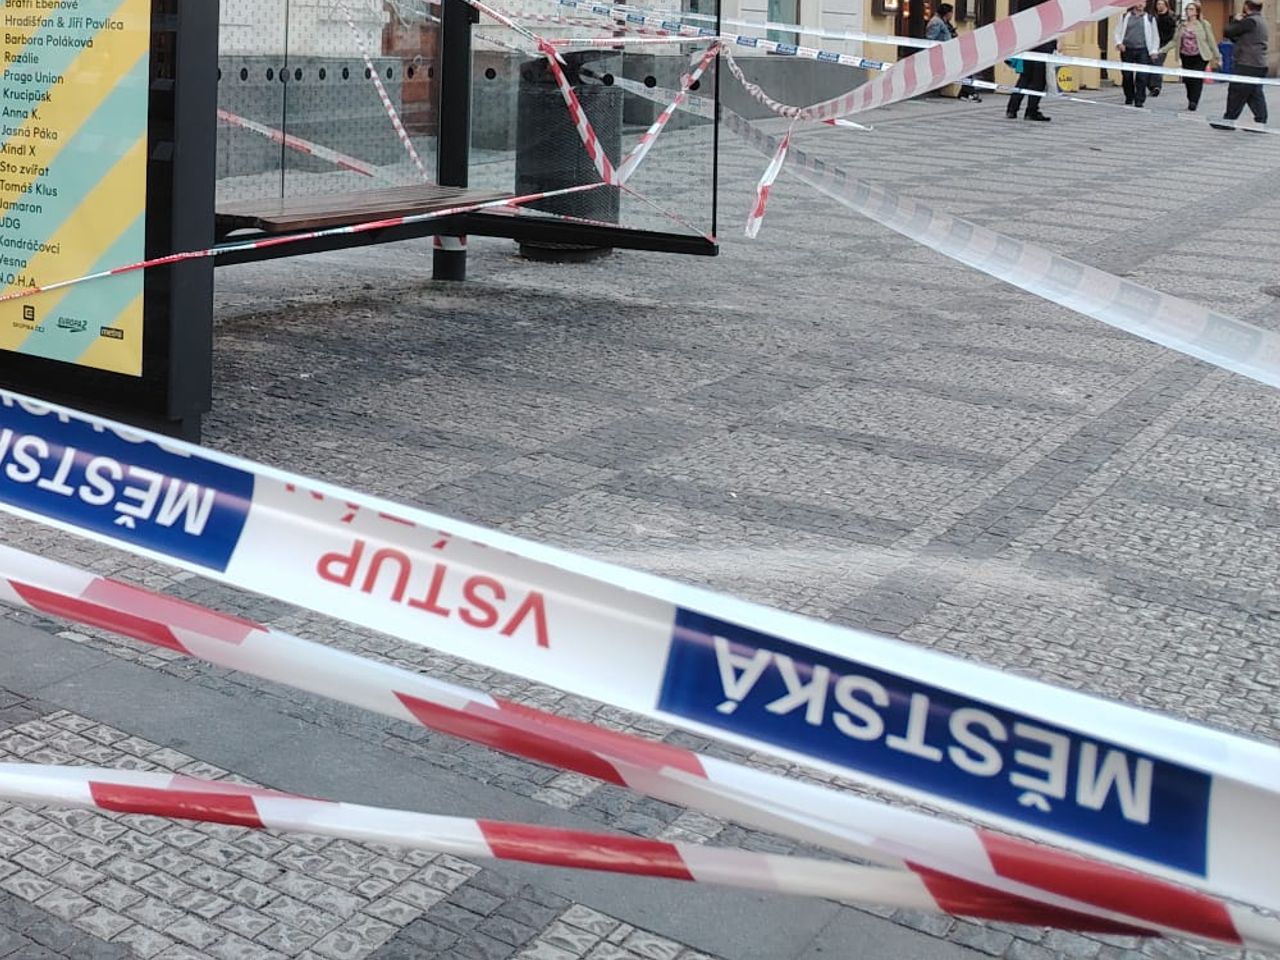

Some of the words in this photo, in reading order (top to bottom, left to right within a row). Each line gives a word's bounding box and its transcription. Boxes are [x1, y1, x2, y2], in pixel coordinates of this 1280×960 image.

[57, 17, 64, 28] &
[85, 18, 123, 30] Pavlica
[5, 33, 43, 46] Barbora
[46, 35, 93, 48] Poláková
[3, 70, 33, 84] Prago
[35, 72, 64, 84] Union
[2, 106, 28, 119] Anna
[31, 108, 41, 120] K.
[1, 124, 31, 138] Jasná
[33, 126, 58, 140] Páka
[0, 142, 26, 156] Xindl
[29, 145, 36, 156] X
[0, 161, 17, 173] Sto
[20, 164, 49, 177] zvířat
[0, 179, 33, 194] Tomáš
[35, 183, 58, 197] Klus
[315, 537, 552, 649] VSTUP
[714, 634, 1155, 826] MĚSTSKÁ
